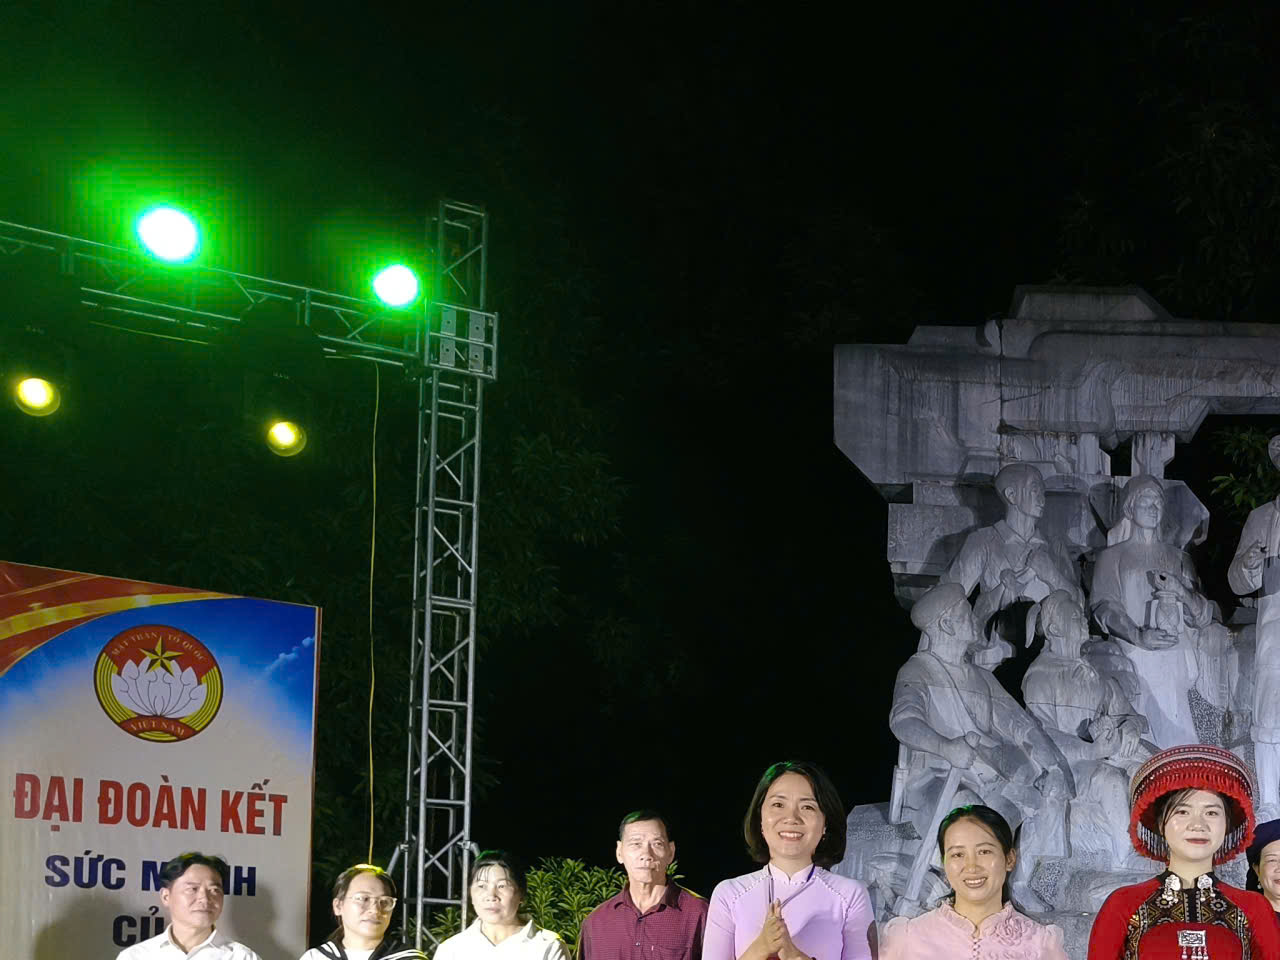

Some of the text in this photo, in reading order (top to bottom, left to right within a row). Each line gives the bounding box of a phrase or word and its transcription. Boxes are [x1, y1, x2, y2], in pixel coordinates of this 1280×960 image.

[13, 773, 287, 836] ĐẠI ĐOÀN KẾT
[45, 850, 256, 896] SỨC MH
[113, 906, 165, 947] CỦ
